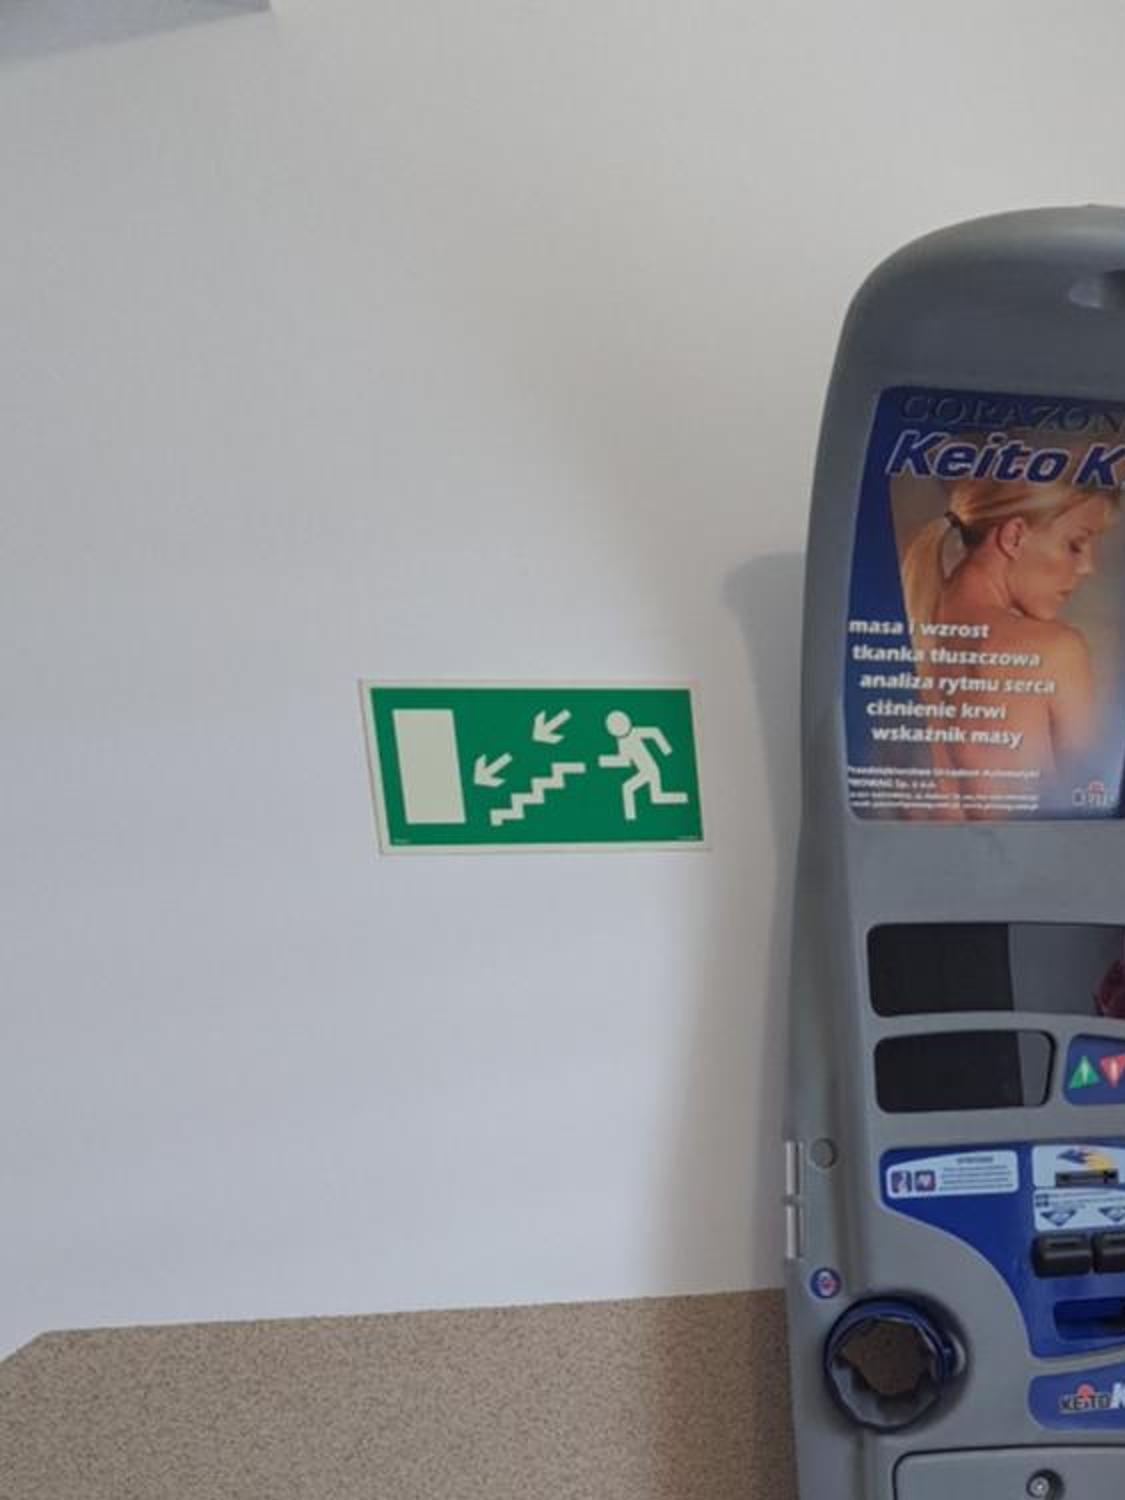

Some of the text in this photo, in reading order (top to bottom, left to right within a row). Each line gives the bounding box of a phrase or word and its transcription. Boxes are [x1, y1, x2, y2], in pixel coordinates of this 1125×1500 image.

[885, 429, 1069, 482] Keito
[849, 620, 903, 635] masa
[920, 623, 989, 638] wzrost
[852, 645, 1040, 667] tkanka tłuszczowa
[860, 672, 1056, 695] analiza rytmu serca
[866, 699, 1006, 719] ciśnienie krwi
[971, 731, 1024, 749] masy
